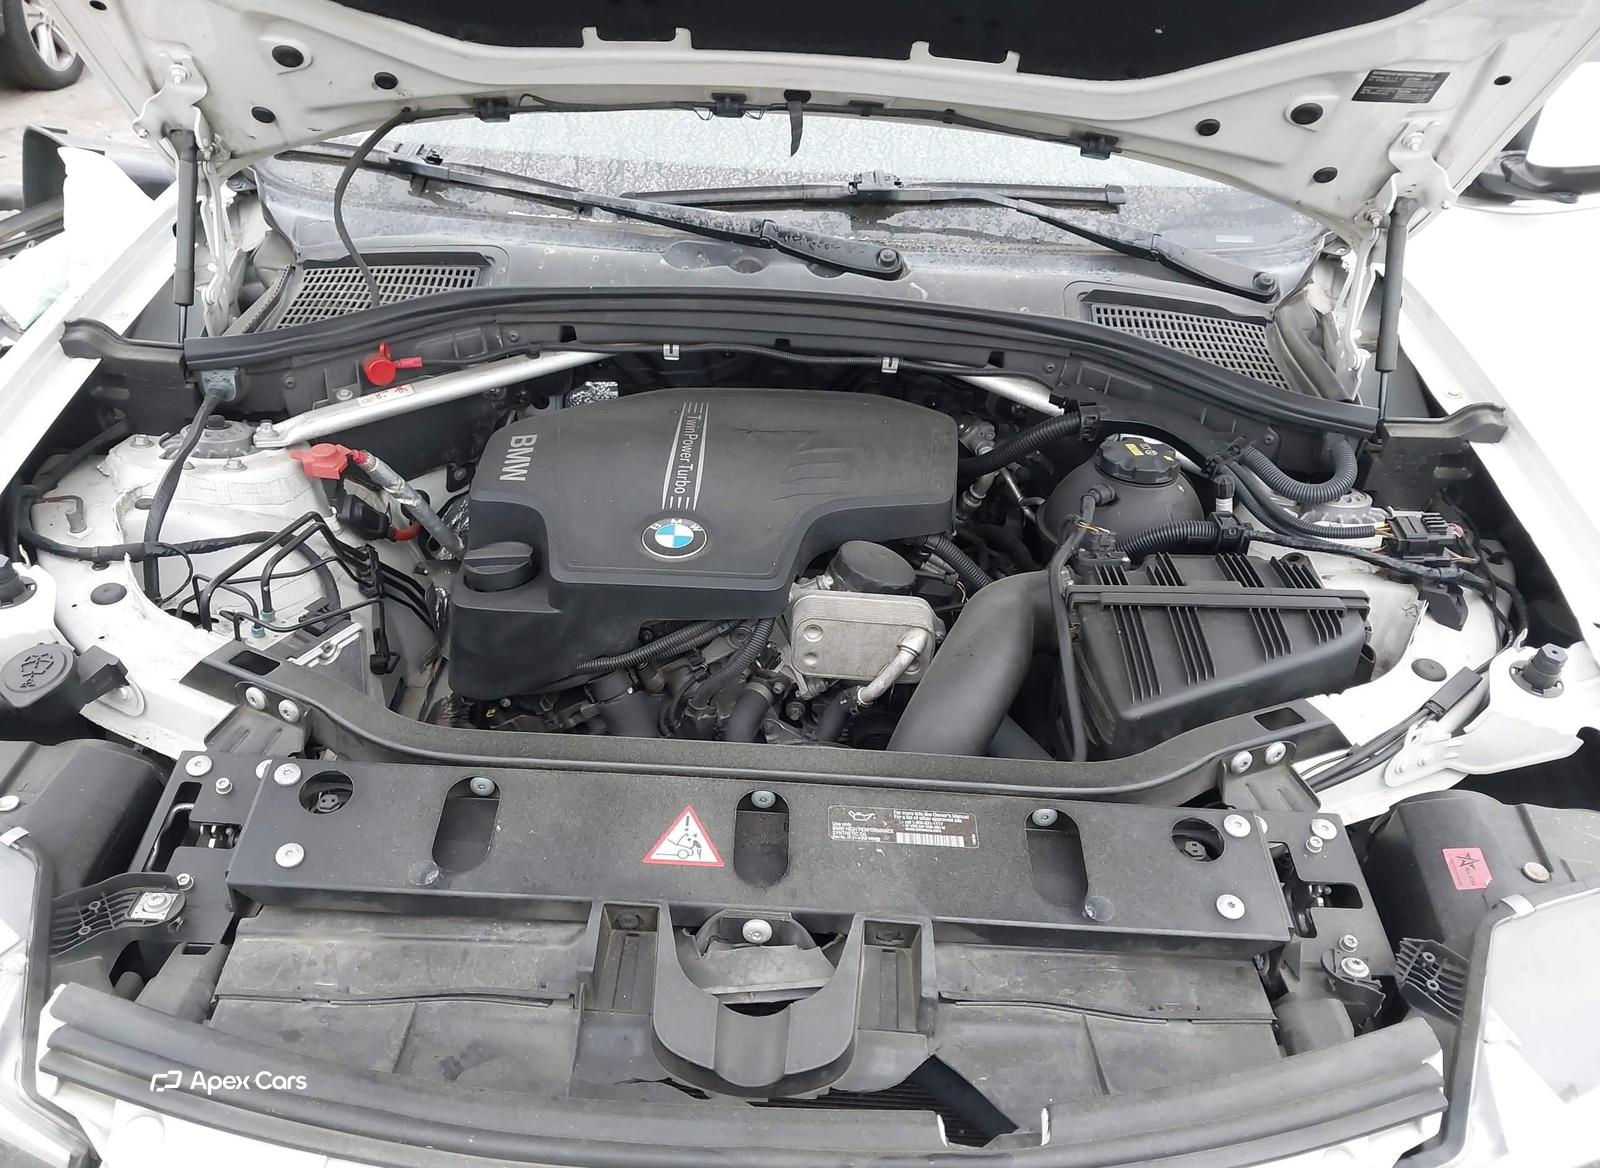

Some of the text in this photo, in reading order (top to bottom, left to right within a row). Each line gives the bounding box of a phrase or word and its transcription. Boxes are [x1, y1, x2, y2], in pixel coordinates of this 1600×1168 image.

[500, 434, 537, 482] BMW
[674, 415, 701, 494] TwinPower Turbo
[650, 518, 702, 531] BMW
